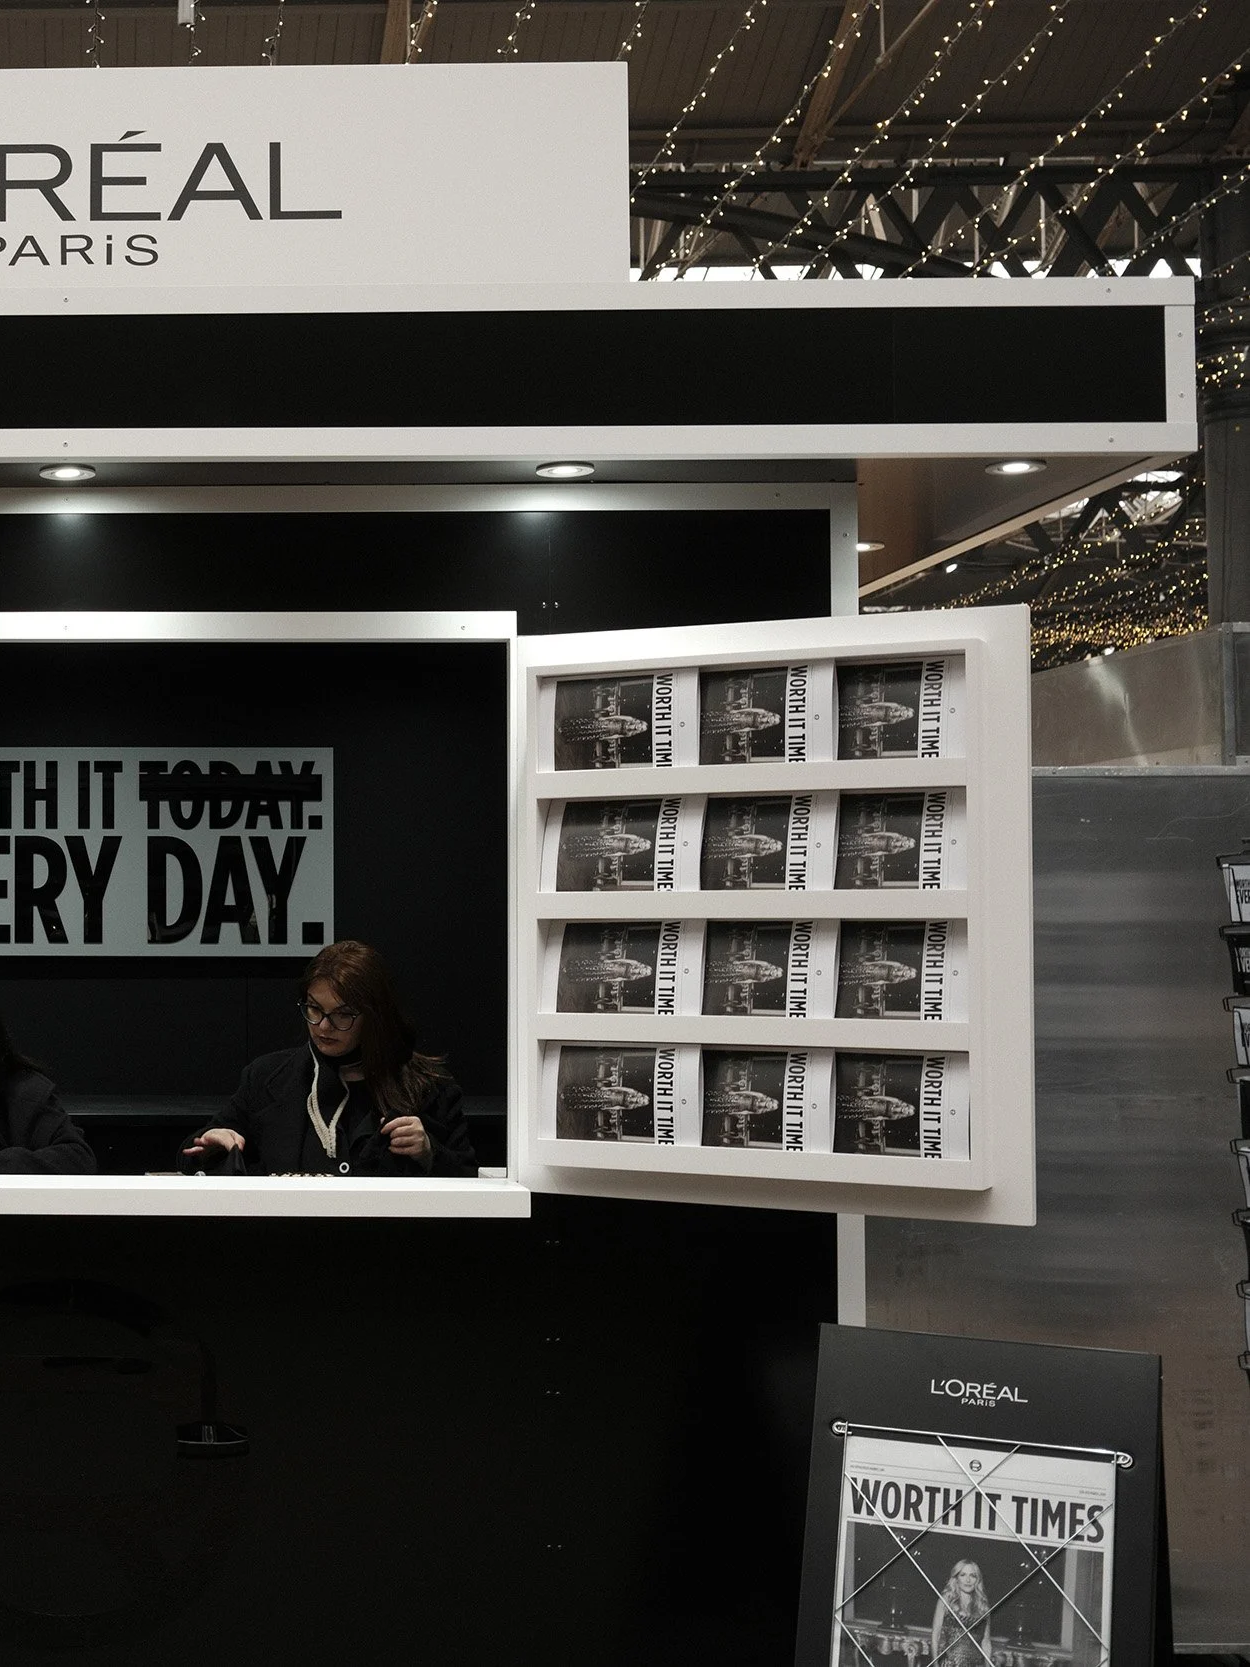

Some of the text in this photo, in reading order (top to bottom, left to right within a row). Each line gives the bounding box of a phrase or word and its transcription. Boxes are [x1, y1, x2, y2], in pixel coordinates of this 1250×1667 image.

[655, 673, 673, 721] WORTH
[655, 725, 672, 736] IT
[788, 665, 808, 762] WORTH IT TIME
[921, 660, 945, 758] WORTH IT TIME
[77, 760, 123, 830] IT
[788, 795, 812, 890] WORTH IT TIME
[922, 792, 947, 889] WORTH IT TIME
[147, 836, 324, 945] DAY.
[657, 798, 682, 891] WORTH IT TIME
[657, 921, 681, 1015] WORTH IT TIME
[789, 921, 813, 1018] WORTH IT TIME
[924, 921, 948, 1020] WORTH IT TIME
[657, 1049, 675, 1145] WORTH IT TIME
[786, 1052, 808, 1151] WORTH IT TIME
[923, 1057, 945, 1159] WORTH IT TIME
[931, 1379, 1029, 1403] L'ORÉAL
[850, 1476, 1105, 1544] WORTH IT TIMES
